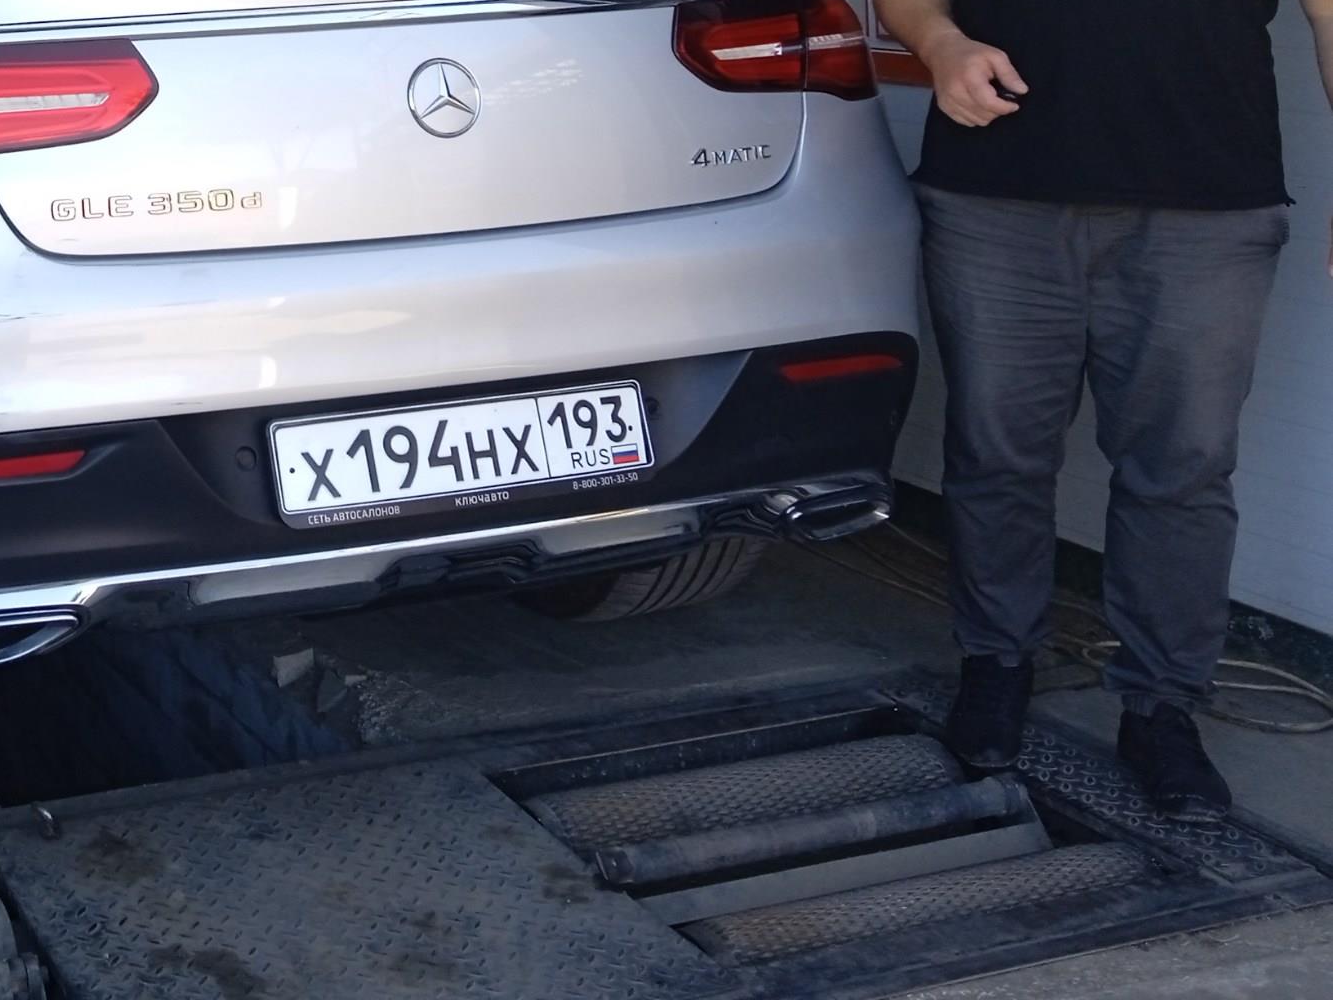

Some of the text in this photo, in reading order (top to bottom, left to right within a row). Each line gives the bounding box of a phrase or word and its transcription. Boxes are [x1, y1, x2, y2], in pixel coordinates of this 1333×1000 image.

[689, 144, 772, 167] 4MATIC
[51, 194, 134, 222] GLE
[300, 395, 628, 502] Х194НХ 193
[571, 448, 611, 470] RUS
[307, 505, 401, 525] СЕТЬ АВТОСАЛОНОВ
